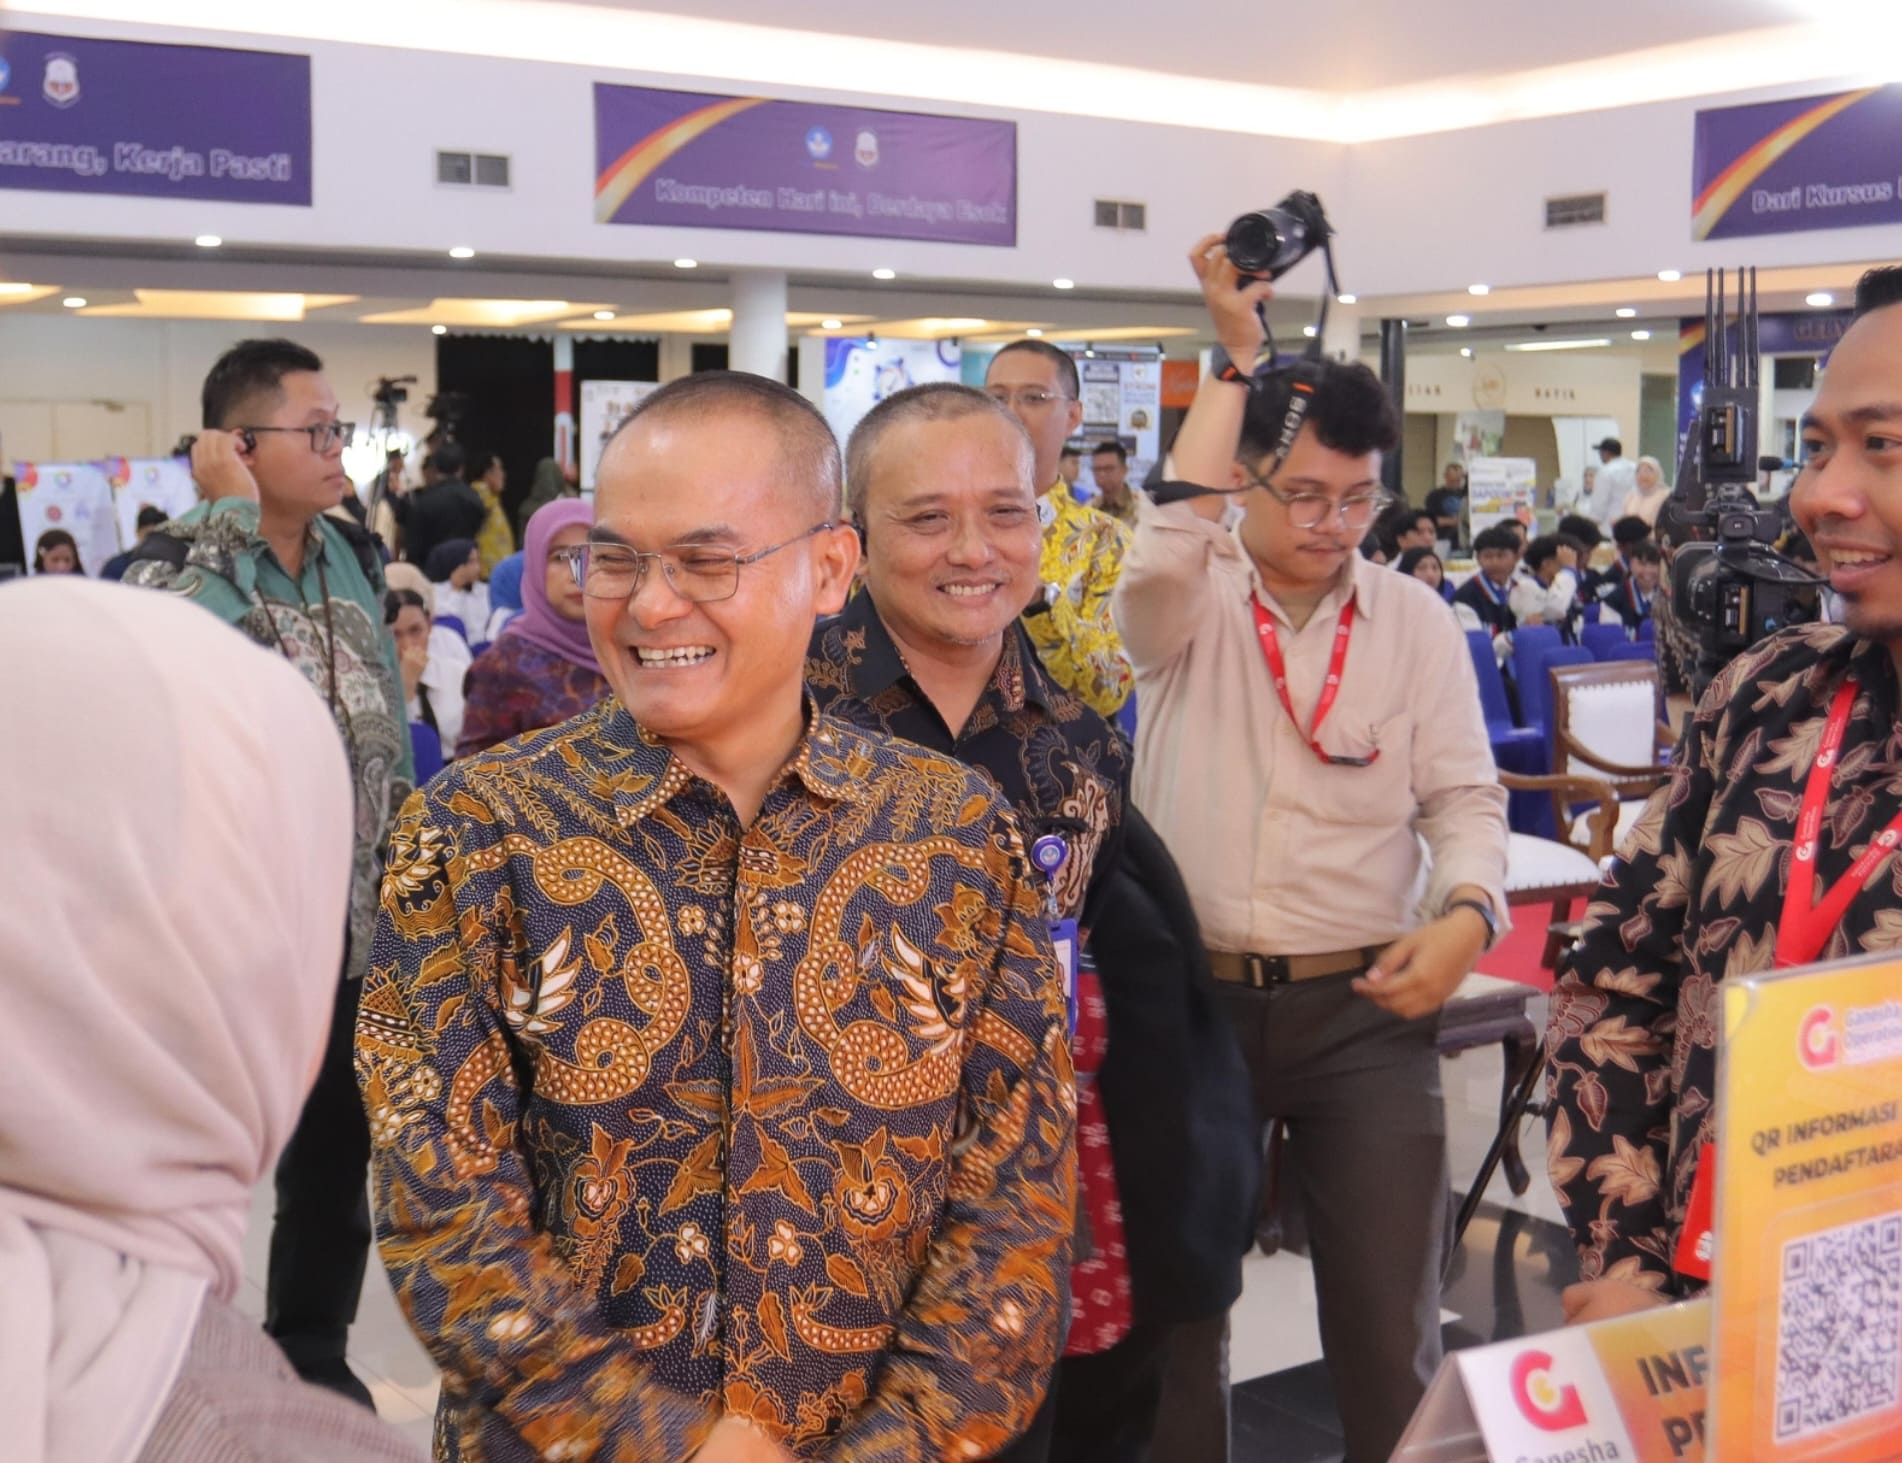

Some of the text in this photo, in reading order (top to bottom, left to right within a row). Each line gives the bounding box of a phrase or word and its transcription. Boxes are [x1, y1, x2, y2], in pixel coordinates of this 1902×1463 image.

[113, 142, 204, 181] Kerja
[209, 148, 292, 182] Pasti
[1752, 186, 1800, 213] Dari
[1805, 182, 1893, 208] Kursus
[1752, 1100, 1897, 1156] QR INFORMASI
